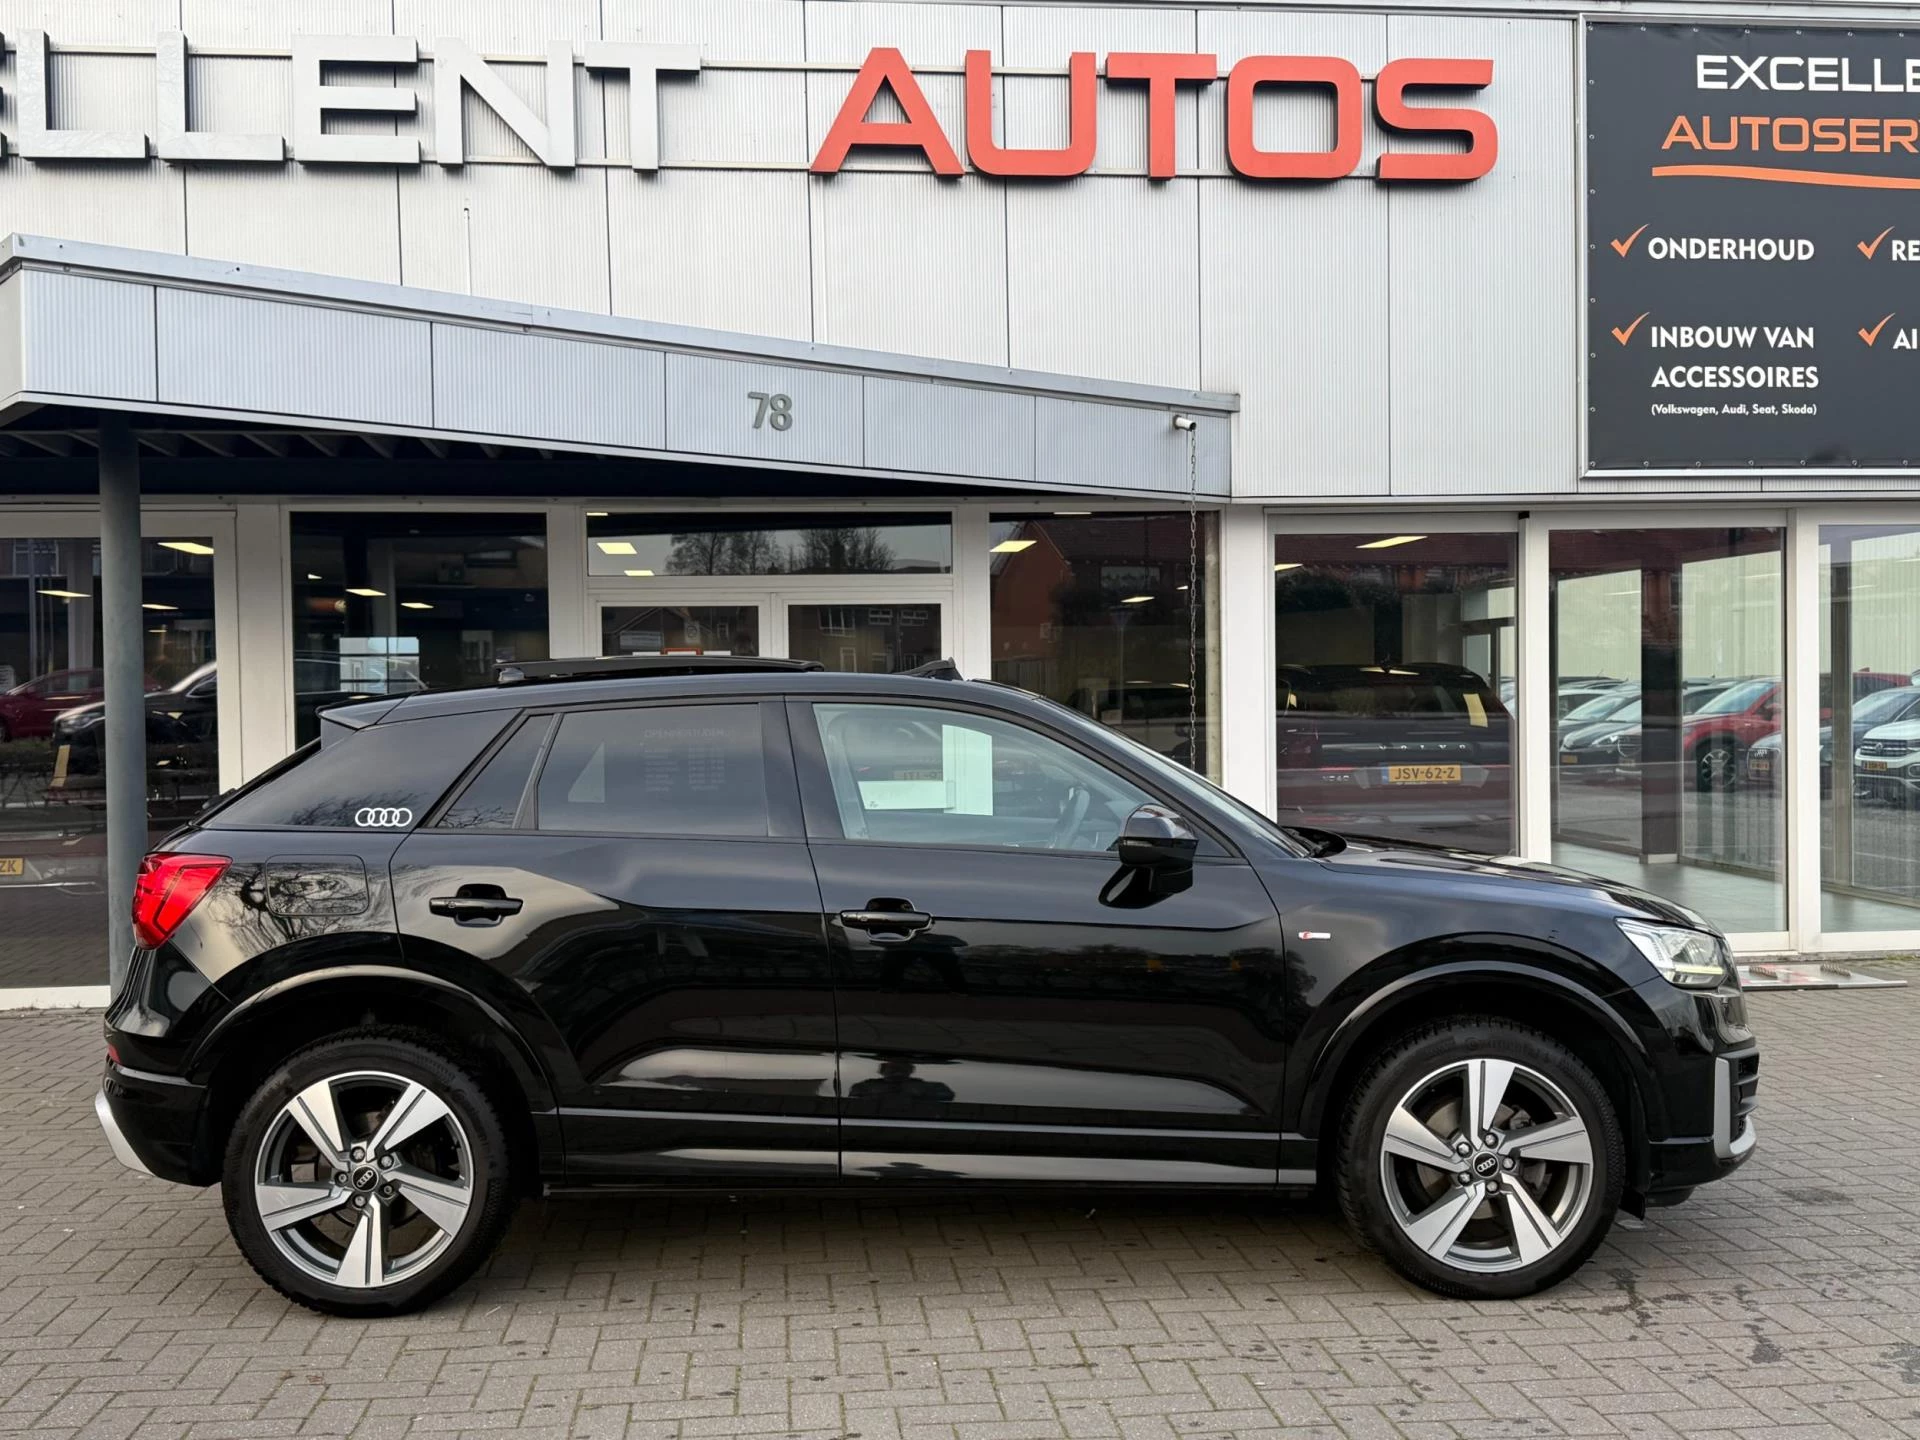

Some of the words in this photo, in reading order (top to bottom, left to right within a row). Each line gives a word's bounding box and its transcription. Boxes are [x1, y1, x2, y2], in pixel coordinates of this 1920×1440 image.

[0, 29, 701, 171] LLENT
[809, 47, 1499, 181] AUTOS
[1661, 115, 1920, 153] AUTOSER
[1648, 237, 1815, 262] ONDERHOUD
[1891, 239, 1920, 262] RE
[1651, 326, 1757, 349] INBOUW
[1763, 326, 1815, 349] VAN
[1892, 328, 1919, 351] AI
[1651, 365, 1820, 389] ACCESSOIRES
[747, 391, 793, 432] 78
[1651, 403, 1719, 417] (Volkswagen,
[1721, 403, 1750, 416] Audi,
[1752, 403, 1779, 416] Seat,
[1781, 403, 1818, 416] Skoda)
[1394, 767, 1456, 780] JSV-62-Z
